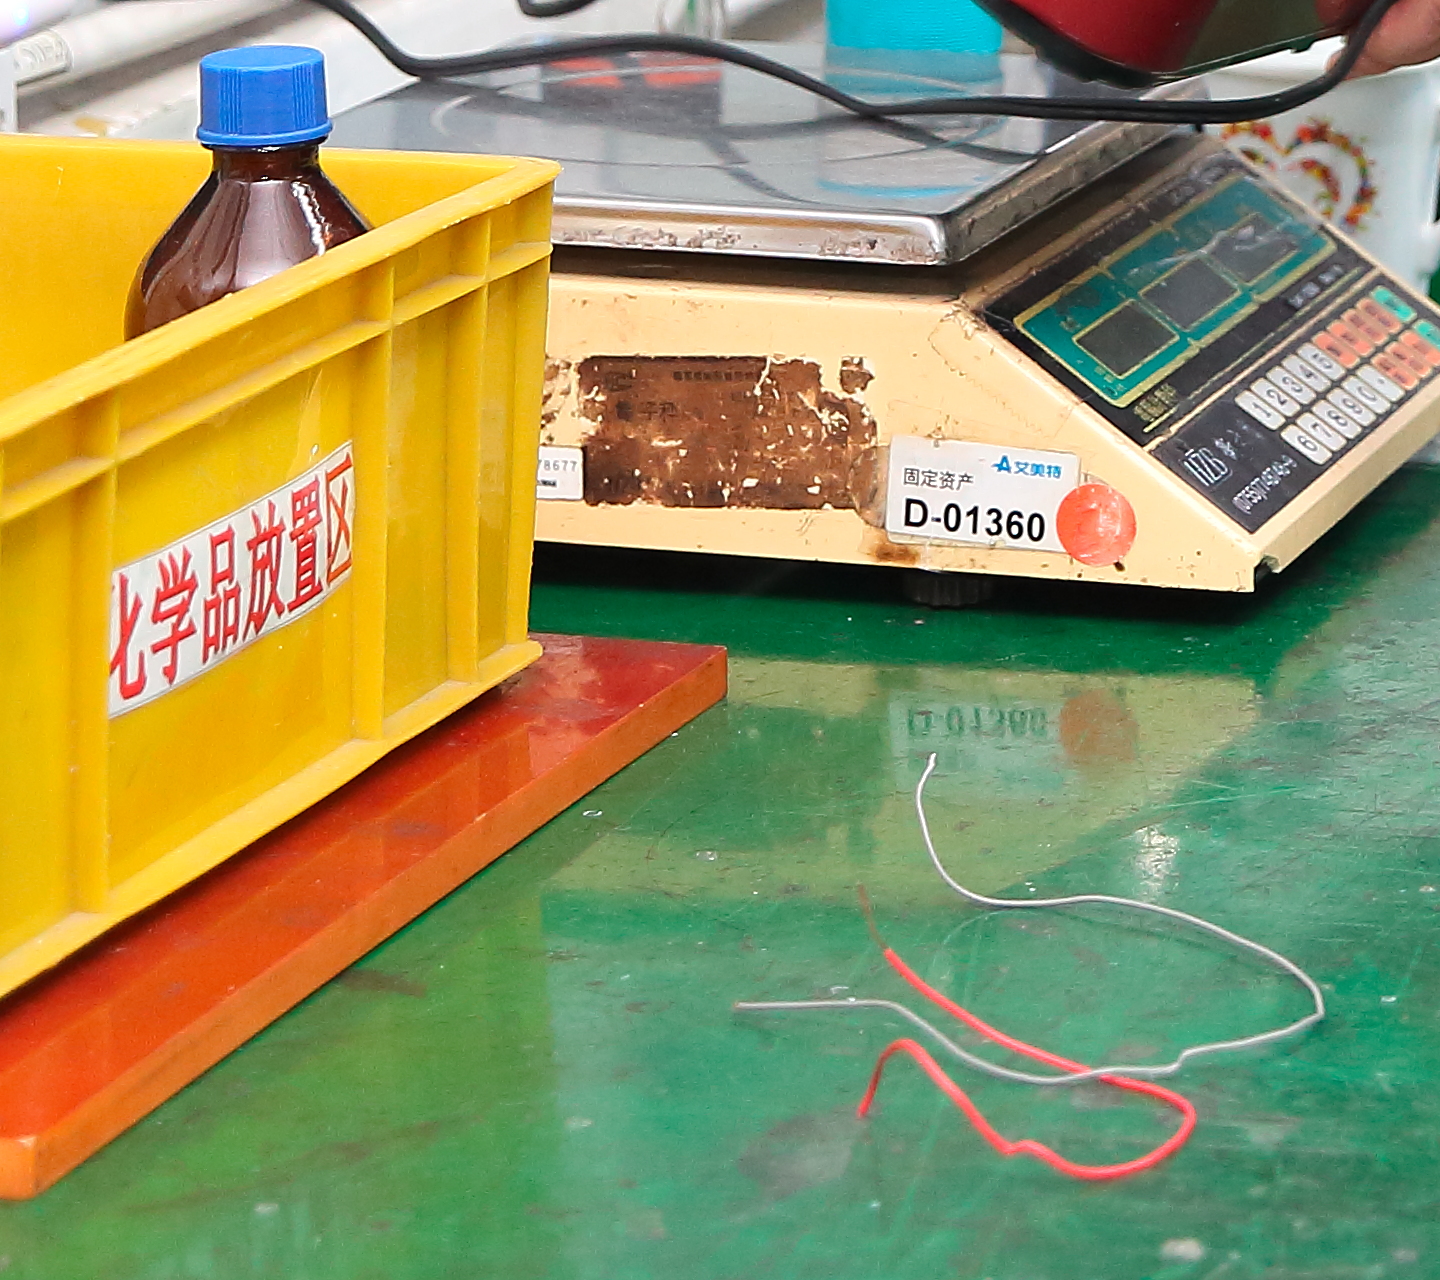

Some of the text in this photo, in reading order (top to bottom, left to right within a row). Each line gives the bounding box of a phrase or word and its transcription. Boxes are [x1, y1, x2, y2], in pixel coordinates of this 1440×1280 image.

[903, 467, 975, 491] 固定资产
[904, 497, 1046, 543] D-01360
[110, 452, 353, 700] 化学品放置区
